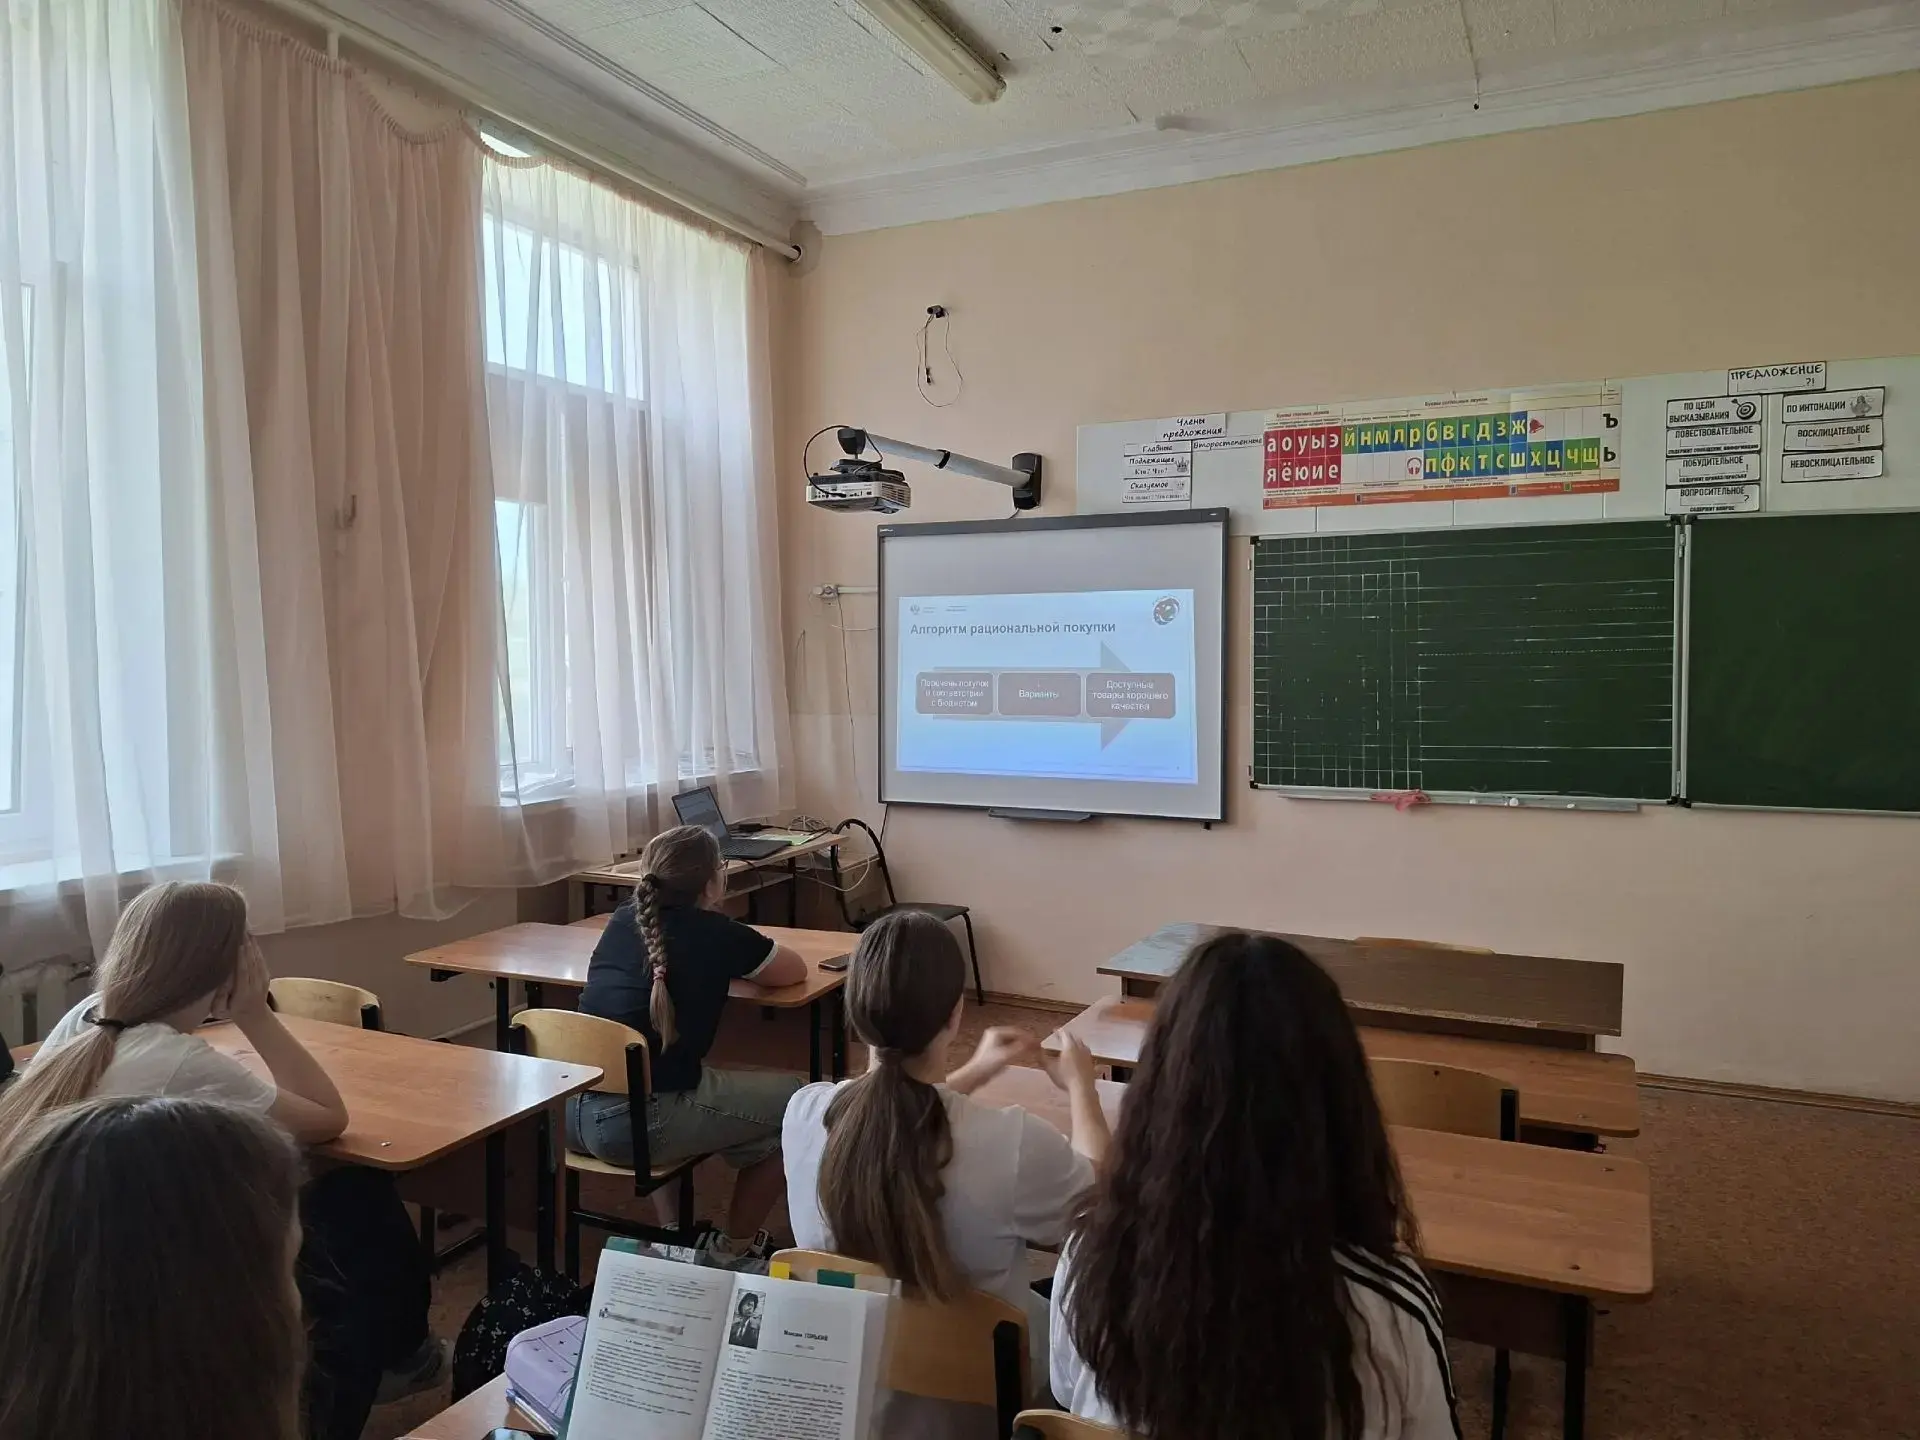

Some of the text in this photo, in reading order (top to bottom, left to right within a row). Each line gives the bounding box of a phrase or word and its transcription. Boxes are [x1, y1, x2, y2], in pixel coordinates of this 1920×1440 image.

[1731, 364, 1823, 380] ПРЕДЛОЖЕНИЕ
[1684, 400, 1715, 411] ПО ЦЕЛИ
[1787, 401, 1846, 413] ПО ИНТОНАЦИИ
[1176, 418, 1205, 426] Члены
[1669, 411, 1730, 423] ВЫСКАЗЫВАНИЯ
[1163, 427, 1222, 440] предложения
[1675, 426, 1753, 438] ПОВЕСТВОВАТЕЛЬНОЕ
[1797, 424, 1870, 437] ВОСКЛИЦАТЕЛЬНОЕ
[1193, 438, 1262, 450] Второстепенные
[1129, 457, 1175, 465] Подлежащее
[1683, 456, 1743, 467] ПОБУДИТЕЛЬНОЕ
[1790, 456, 1875, 468] НЕВОСКЛИЦАТЕЛЬНОЕ
[1131, 482, 1168, 490] Сказуемое
[1680, 486, 1745, 497] ВОПРОСИТЕЛЬНОЕ
[910, 621, 1116, 636] Алгоритм рациональной покупки
[1019, 689, 1059, 699] Варианты
[1093, 692, 1169, 701] товары хорошего
